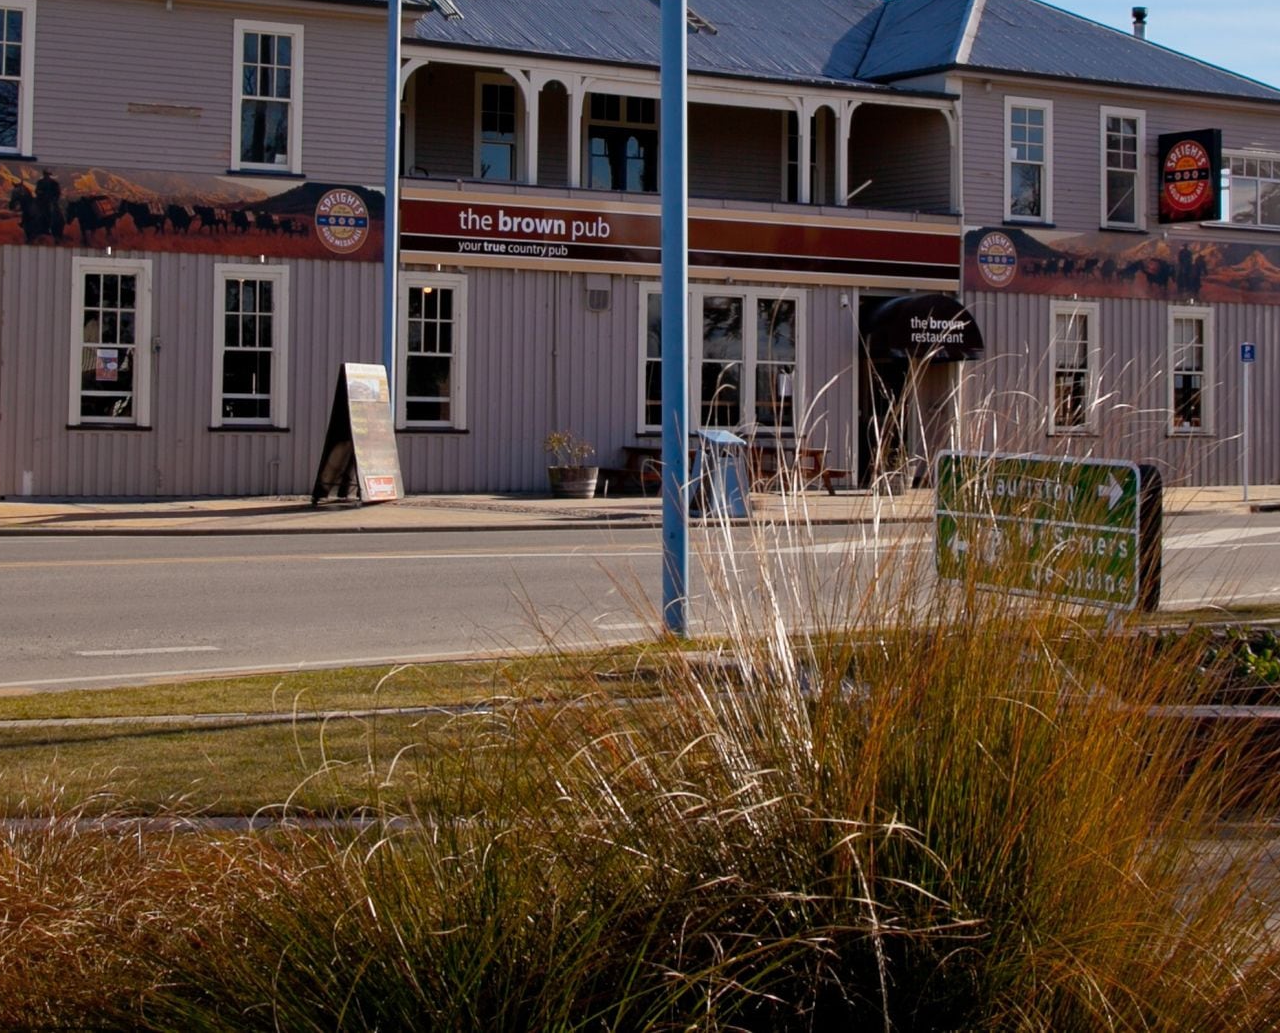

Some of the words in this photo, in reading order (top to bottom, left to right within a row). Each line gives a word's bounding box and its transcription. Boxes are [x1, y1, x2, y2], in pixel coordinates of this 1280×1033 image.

[459, 208, 493, 231] the
[498, 209, 566, 235] brown
[571, 216, 610, 241] pub
[458, 241, 482, 253] your
[483, 241, 506, 253] true
[508, 244, 547, 257] country
[548, 245, 568, 258] pub
[910, 316, 928, 329] the
[930, 316, 964, 330] brown
[911, 332, 964, 344] restaurant
